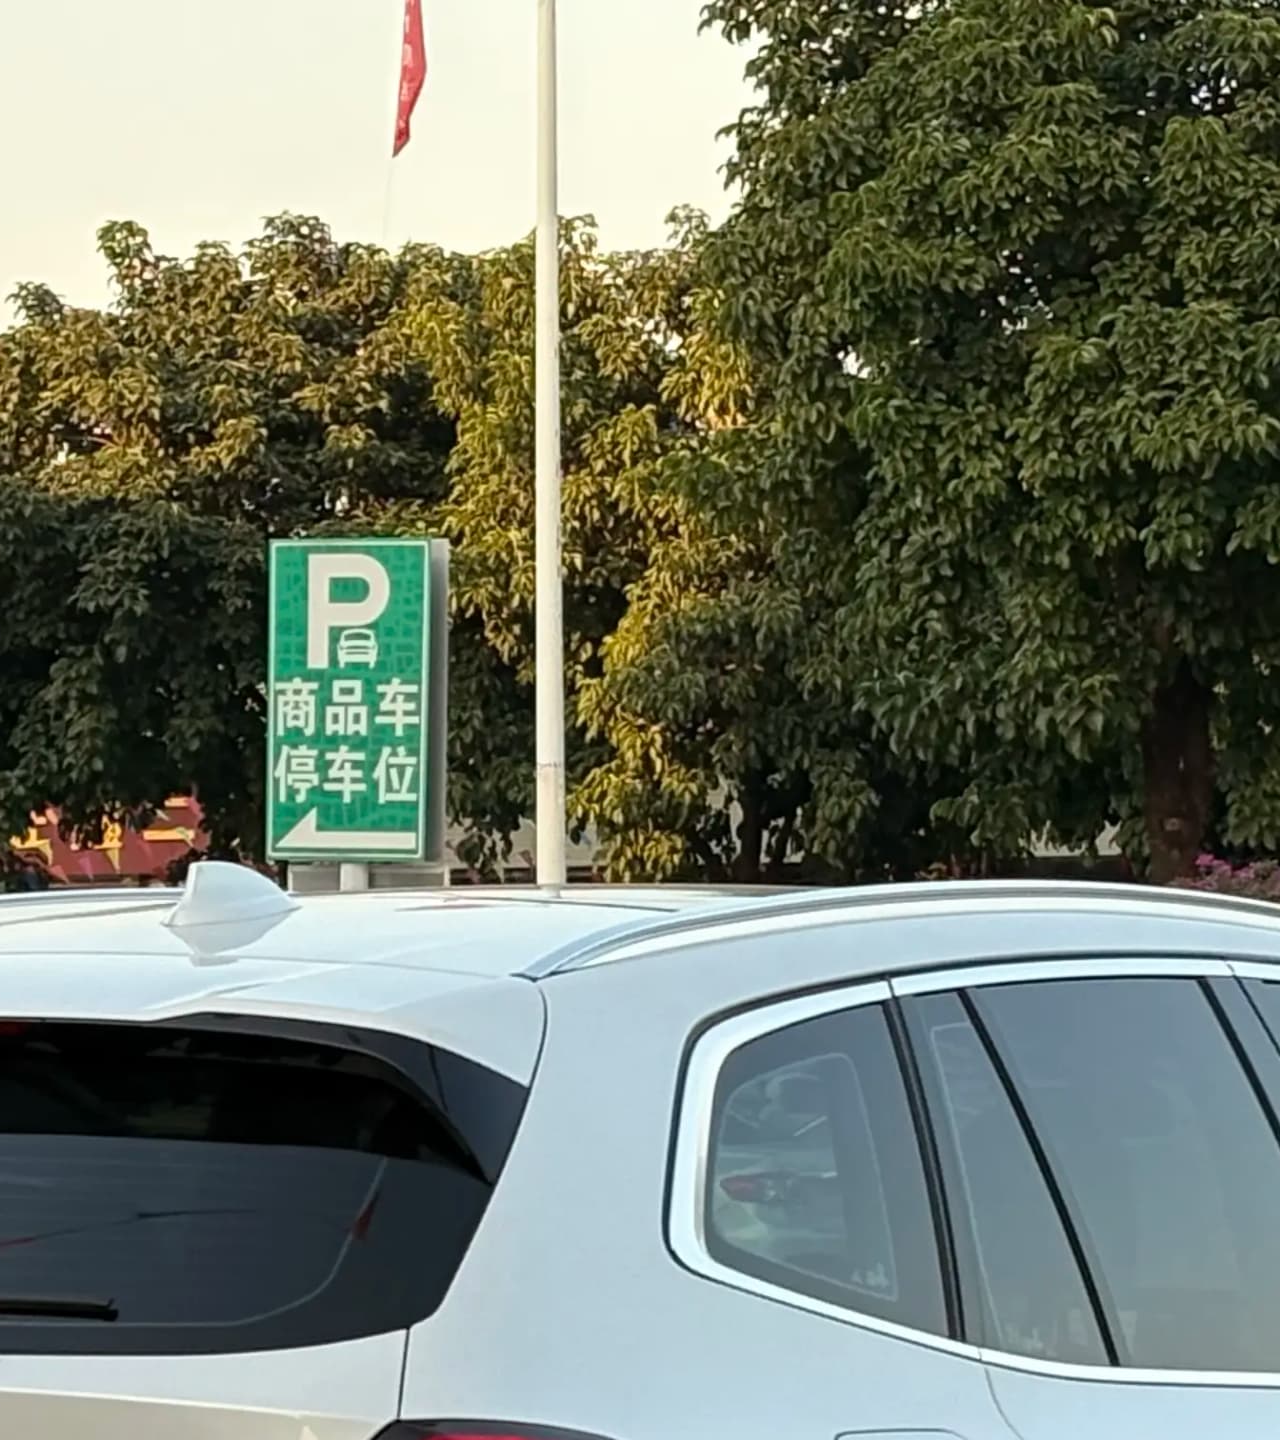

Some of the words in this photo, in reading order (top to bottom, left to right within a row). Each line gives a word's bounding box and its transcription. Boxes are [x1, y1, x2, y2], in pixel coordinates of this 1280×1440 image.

[307, 553, 391, 669] P
[275, 677, 420, 737] 商品车
[273, 744, 418, 804] 停车位
